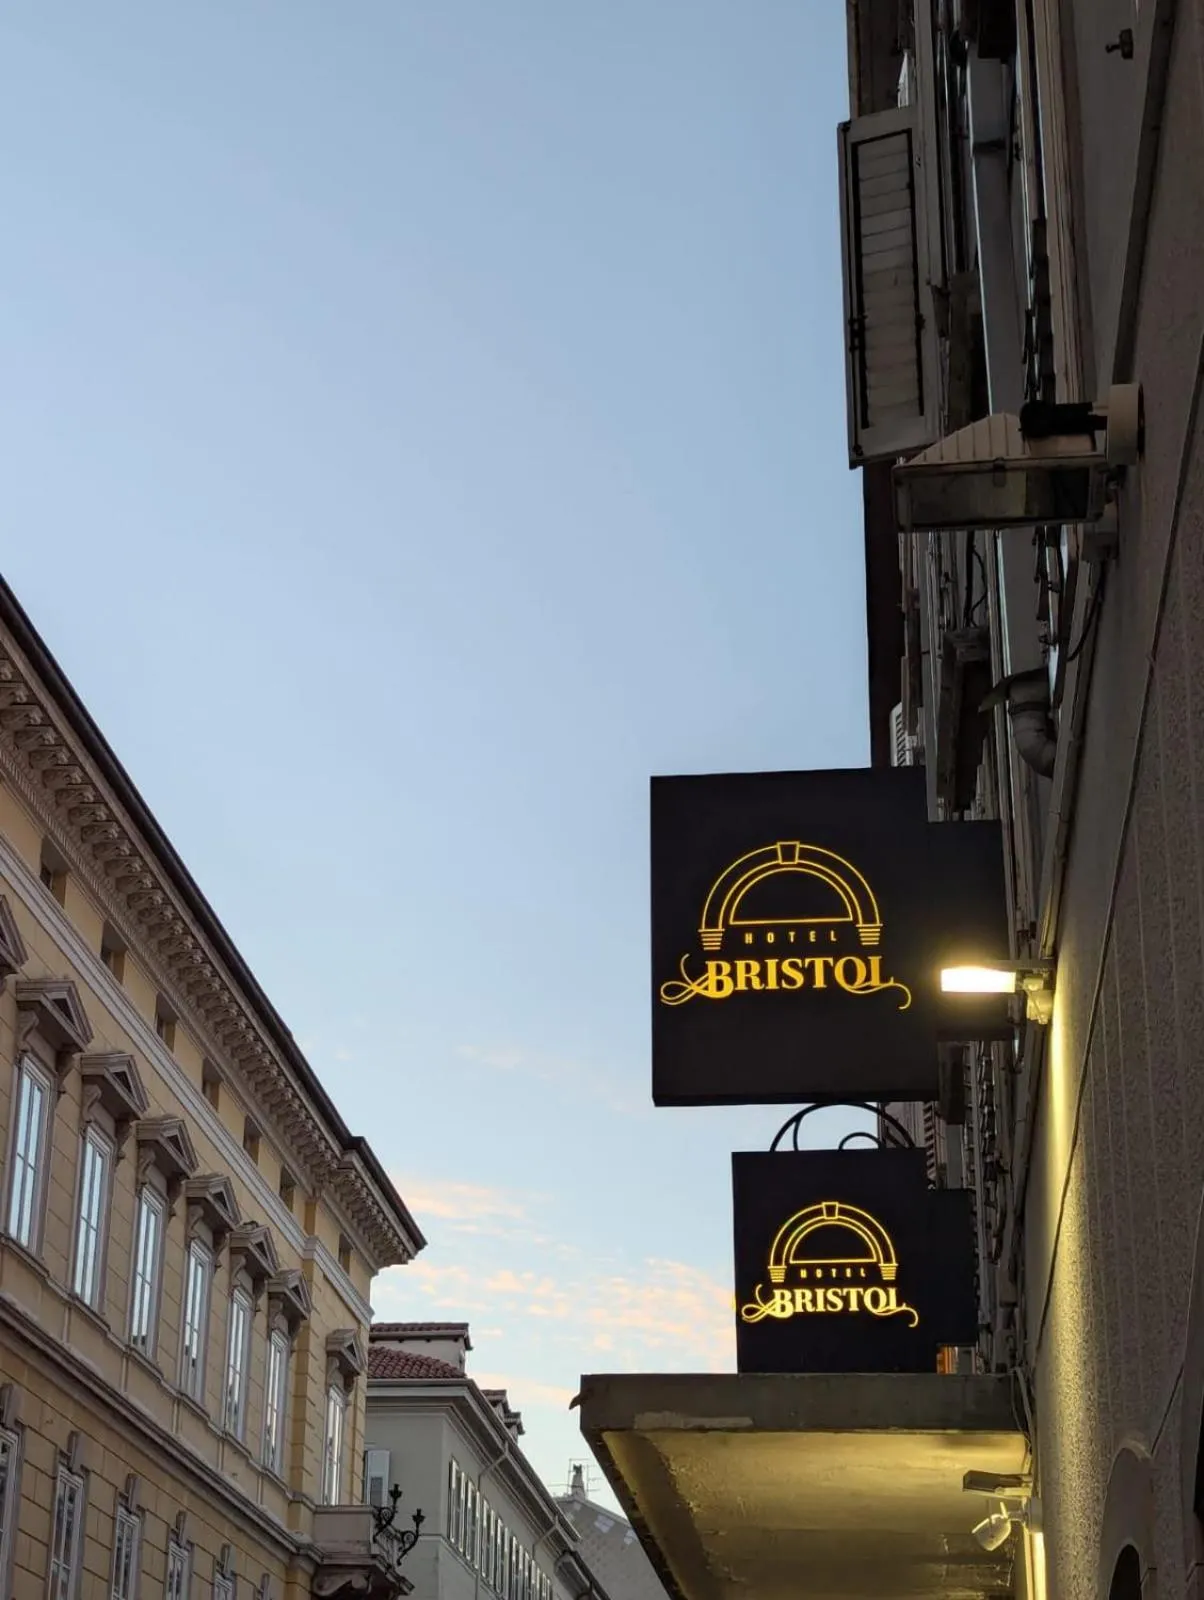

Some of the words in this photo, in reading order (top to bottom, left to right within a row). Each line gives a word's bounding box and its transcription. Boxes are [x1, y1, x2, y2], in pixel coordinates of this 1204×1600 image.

[744, 930, 837, 944] HOTEL
[661, 954, 911, 1008] BRISTOL
[799, 1267, 867, 1279] HOTEL
[742, 1284, 918, 1327] BRISTOL
